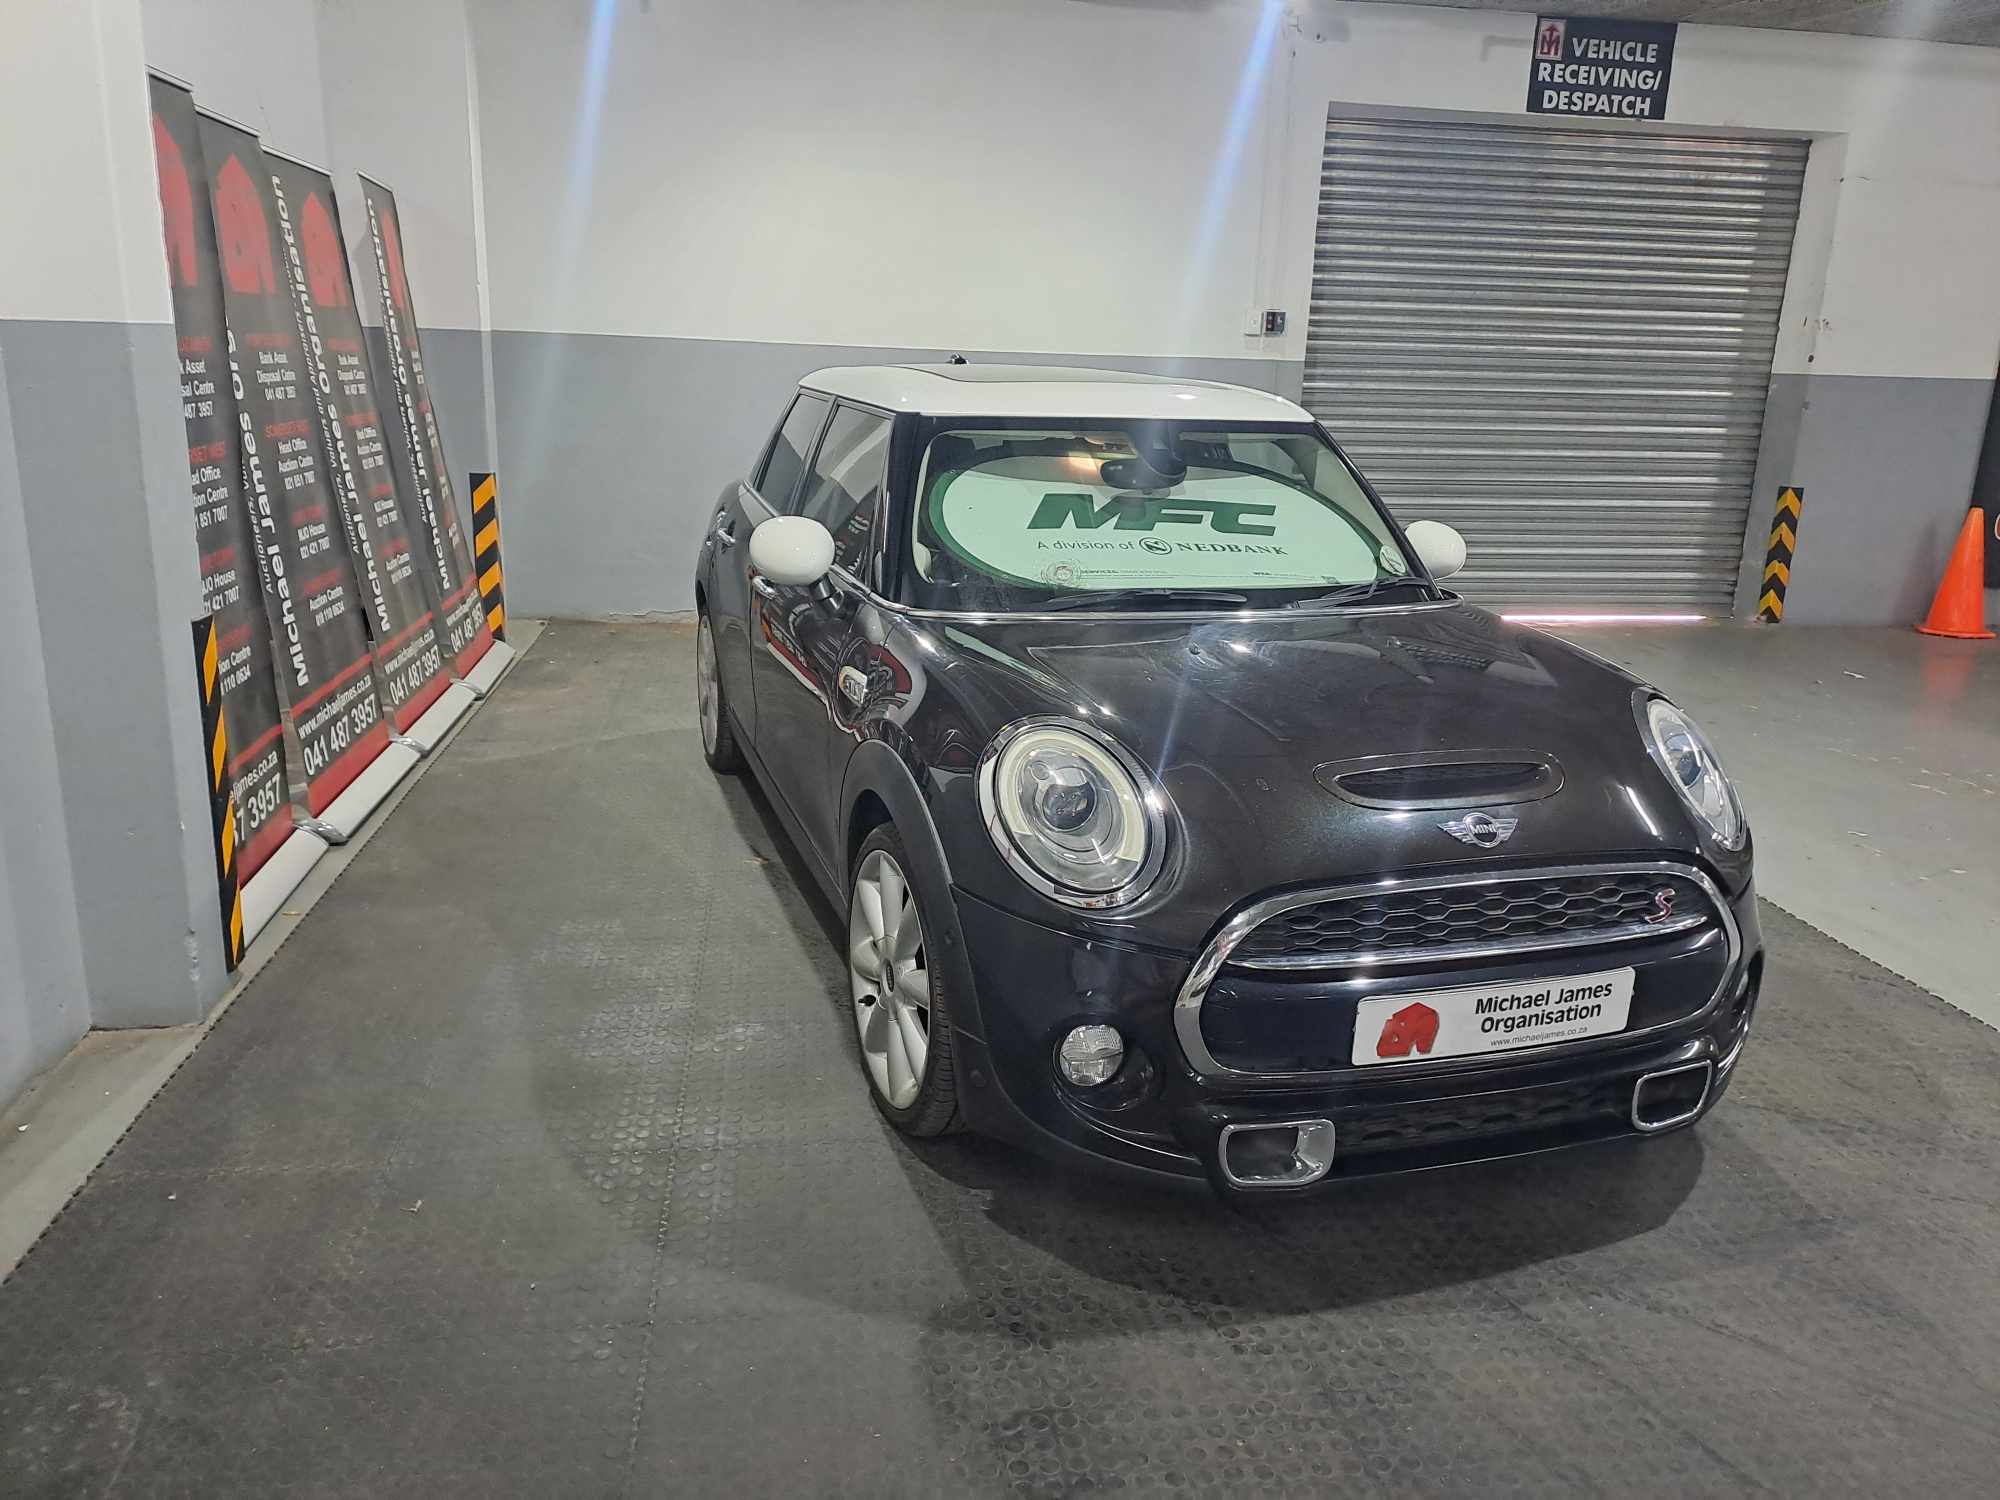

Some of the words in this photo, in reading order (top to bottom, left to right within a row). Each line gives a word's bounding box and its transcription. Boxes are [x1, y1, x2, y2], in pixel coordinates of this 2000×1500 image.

[1572, 37, 1658, 63] VEHICLE
[1537, 62, 1662, 91] RECEIVING/
[1542, 90, 1651, 116] DESPATCH
[272, 175, 331, 394] Organisation
[328, 403, 359, 504] James
[404, 393, 427, 480] James
[200, 465, 222, 482] Office
[240, 412, 276, 534] James
[1027, 493, 1276, 536] MFC
[248, 496, 274, 594] Auctioneers,
[1037, 540, 1049, 550] A
[1053, 537, 1114, 550] division
[1119, 539, 1135, 550] of
[1176, 542, 1288, 556] NEDBANK
[213, 568, 236, 589] House
[353, 513, 391, 632] Michael
[267, 544, 309, 687] Michael
[390, 675, 409, 705] 041
[408, 660, 424, 689] 487
[303, 739, 330, 776] 041
[330, 725, 352, 754] 487
[351, 693, 378, 734] 3957
[248, 771, 281, 829] 3957
[1469, 823, 1497, 835] MINI
[1475, 989, 1551, 1014] Michael
[1554, 983, 1613, 1005] James
[1480, 1003, 1602, 1034] Organisation
